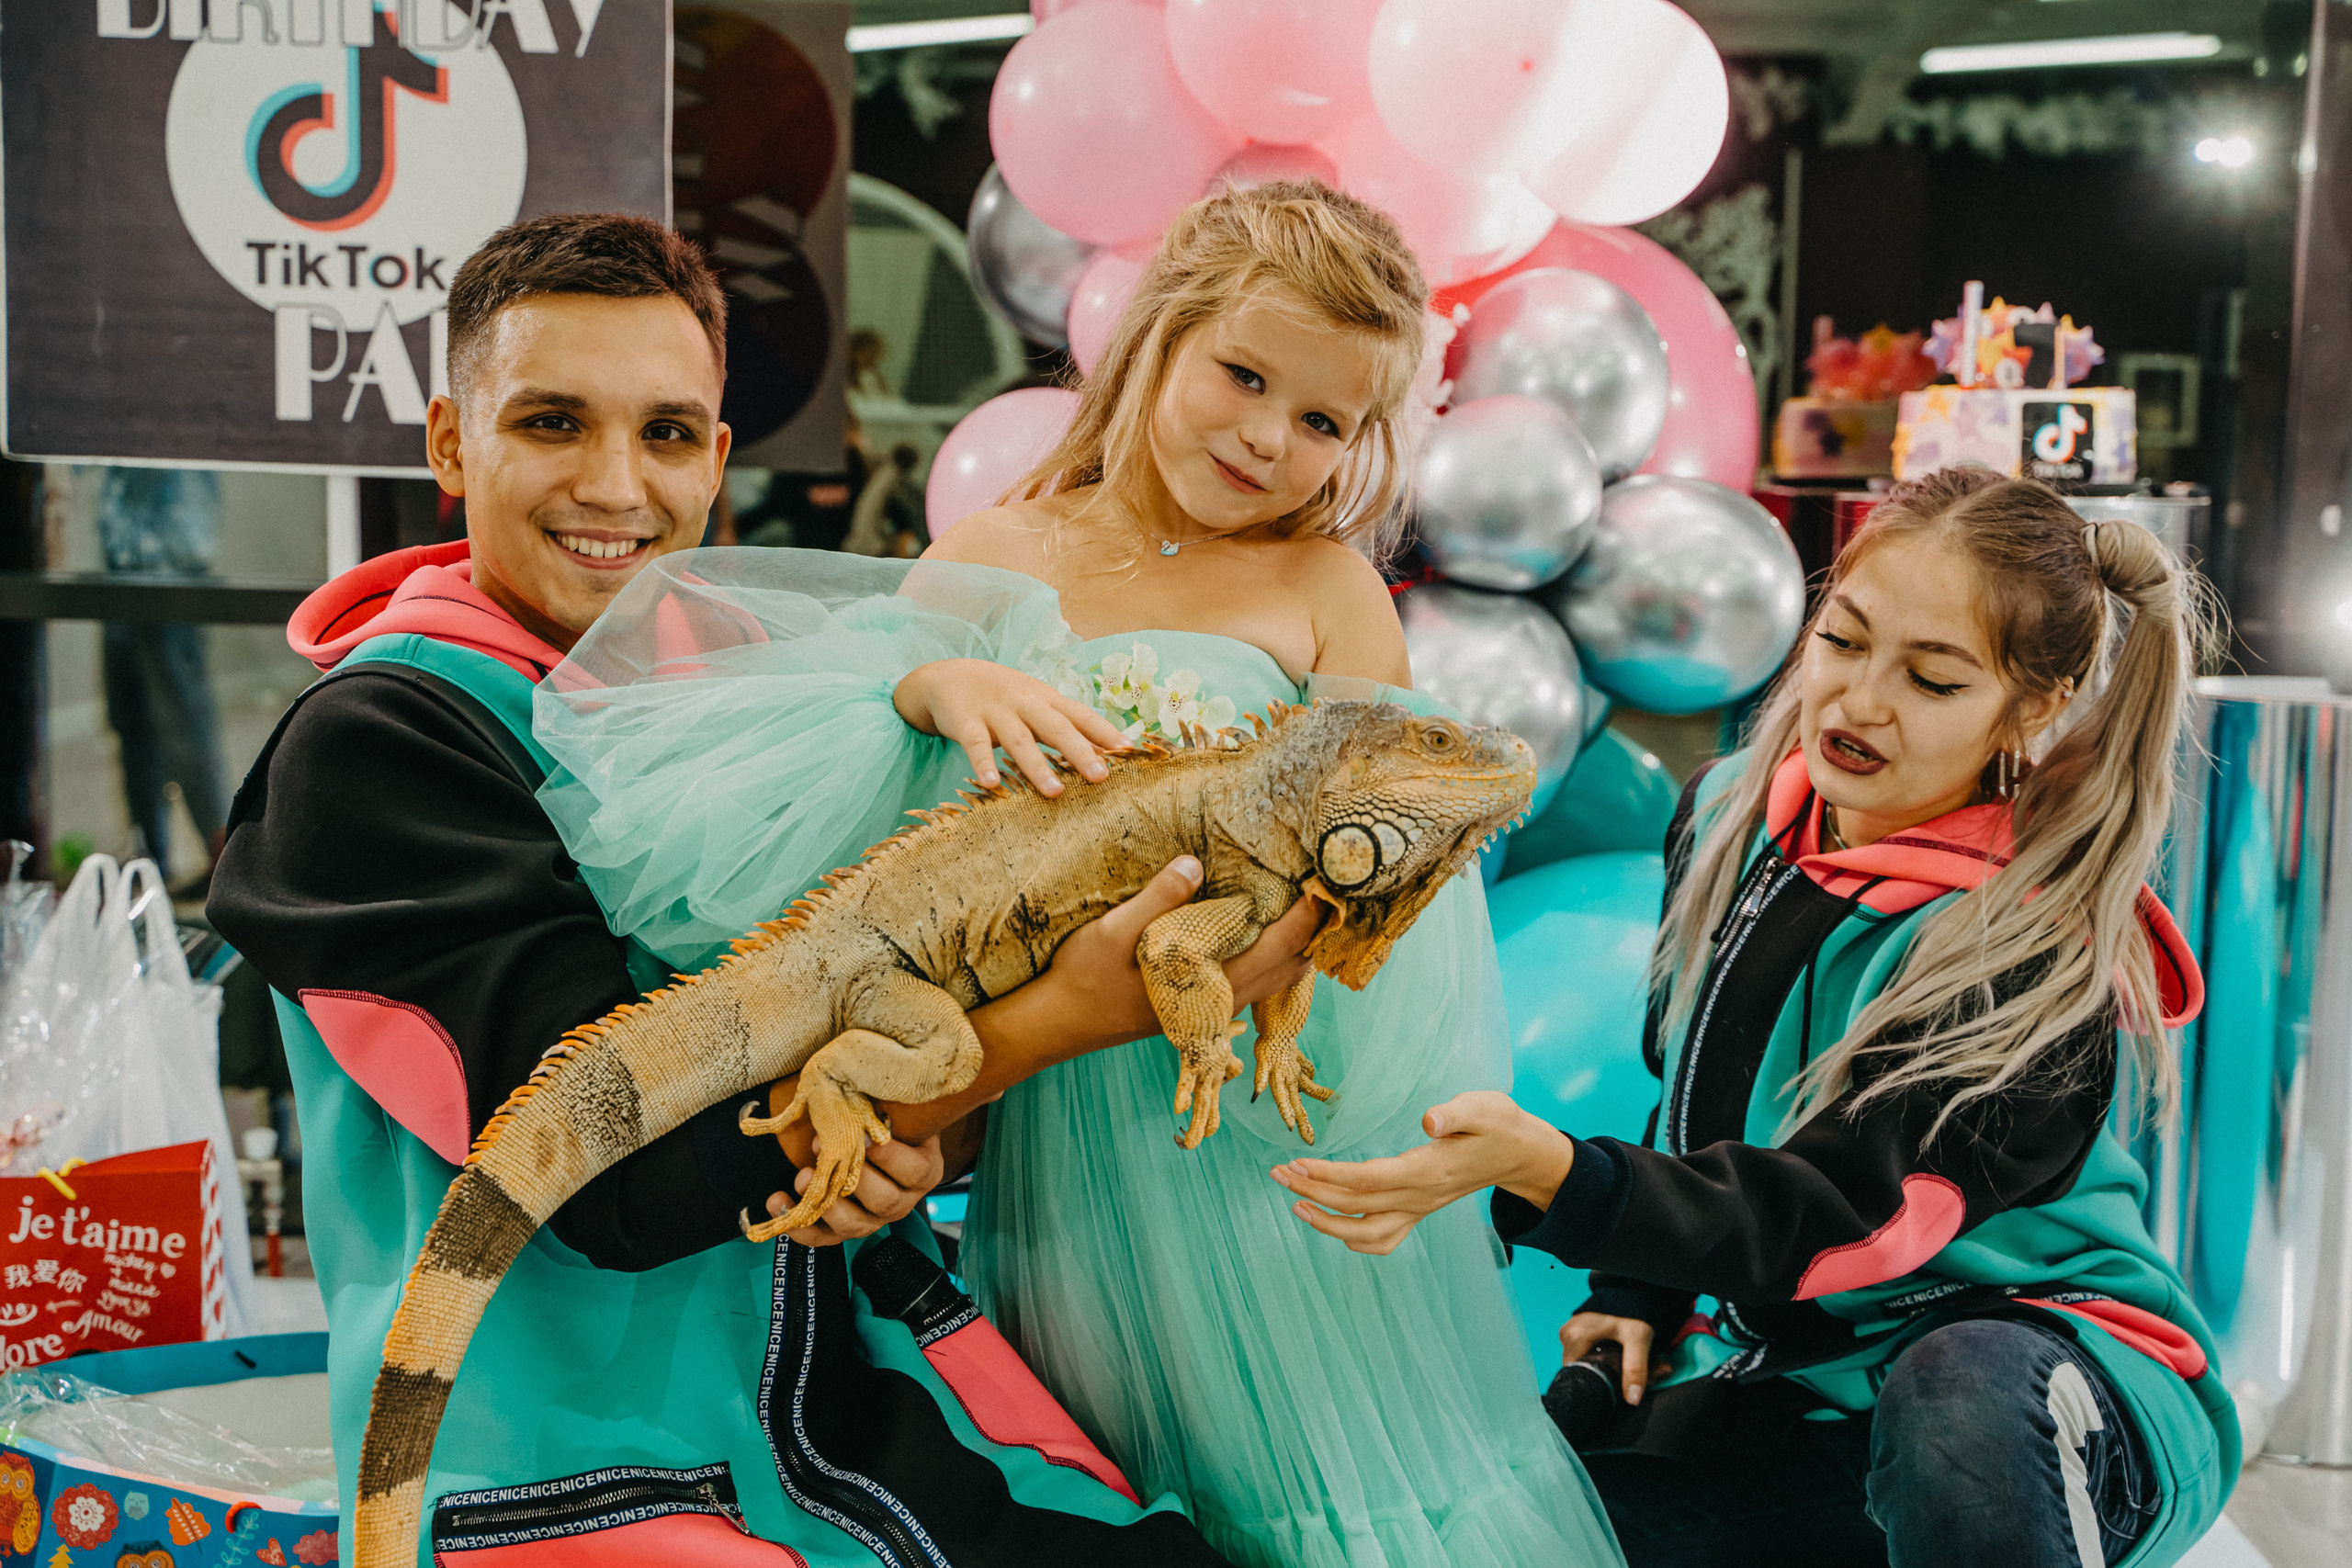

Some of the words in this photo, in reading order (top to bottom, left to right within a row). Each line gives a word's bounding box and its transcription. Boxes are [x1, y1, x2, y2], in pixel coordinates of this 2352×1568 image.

[245, 241, 446, 290] TikTok
[8, 1195, 55, 1244] je
[60, 1205, 187, 1258] t'aime
[5, 1258, 87, 1293] 我爱你
